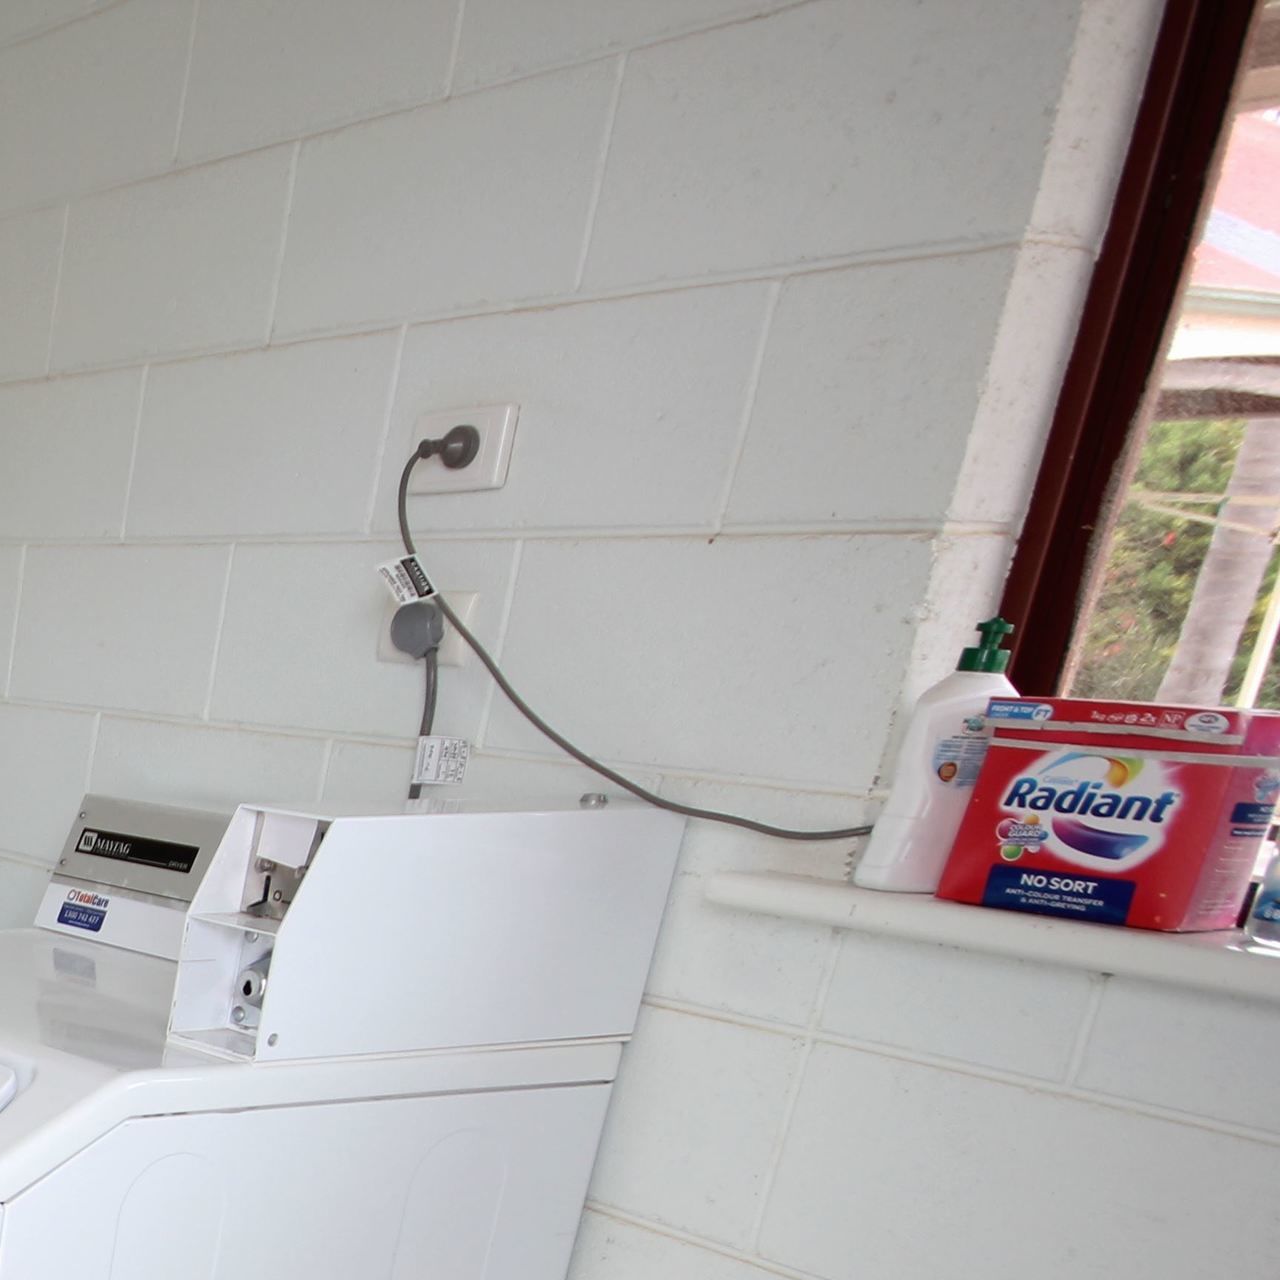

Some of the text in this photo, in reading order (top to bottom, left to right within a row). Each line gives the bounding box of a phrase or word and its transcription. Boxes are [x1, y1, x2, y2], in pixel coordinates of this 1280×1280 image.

[1003, 777, 1176, 824] Radiant
[95, 838, 132, 855] MAYTAG
[1020, 873, 1098, 895] NO SORT
[1005, 887, 1104, 907] ANTI-COLOUR TRANSFER
